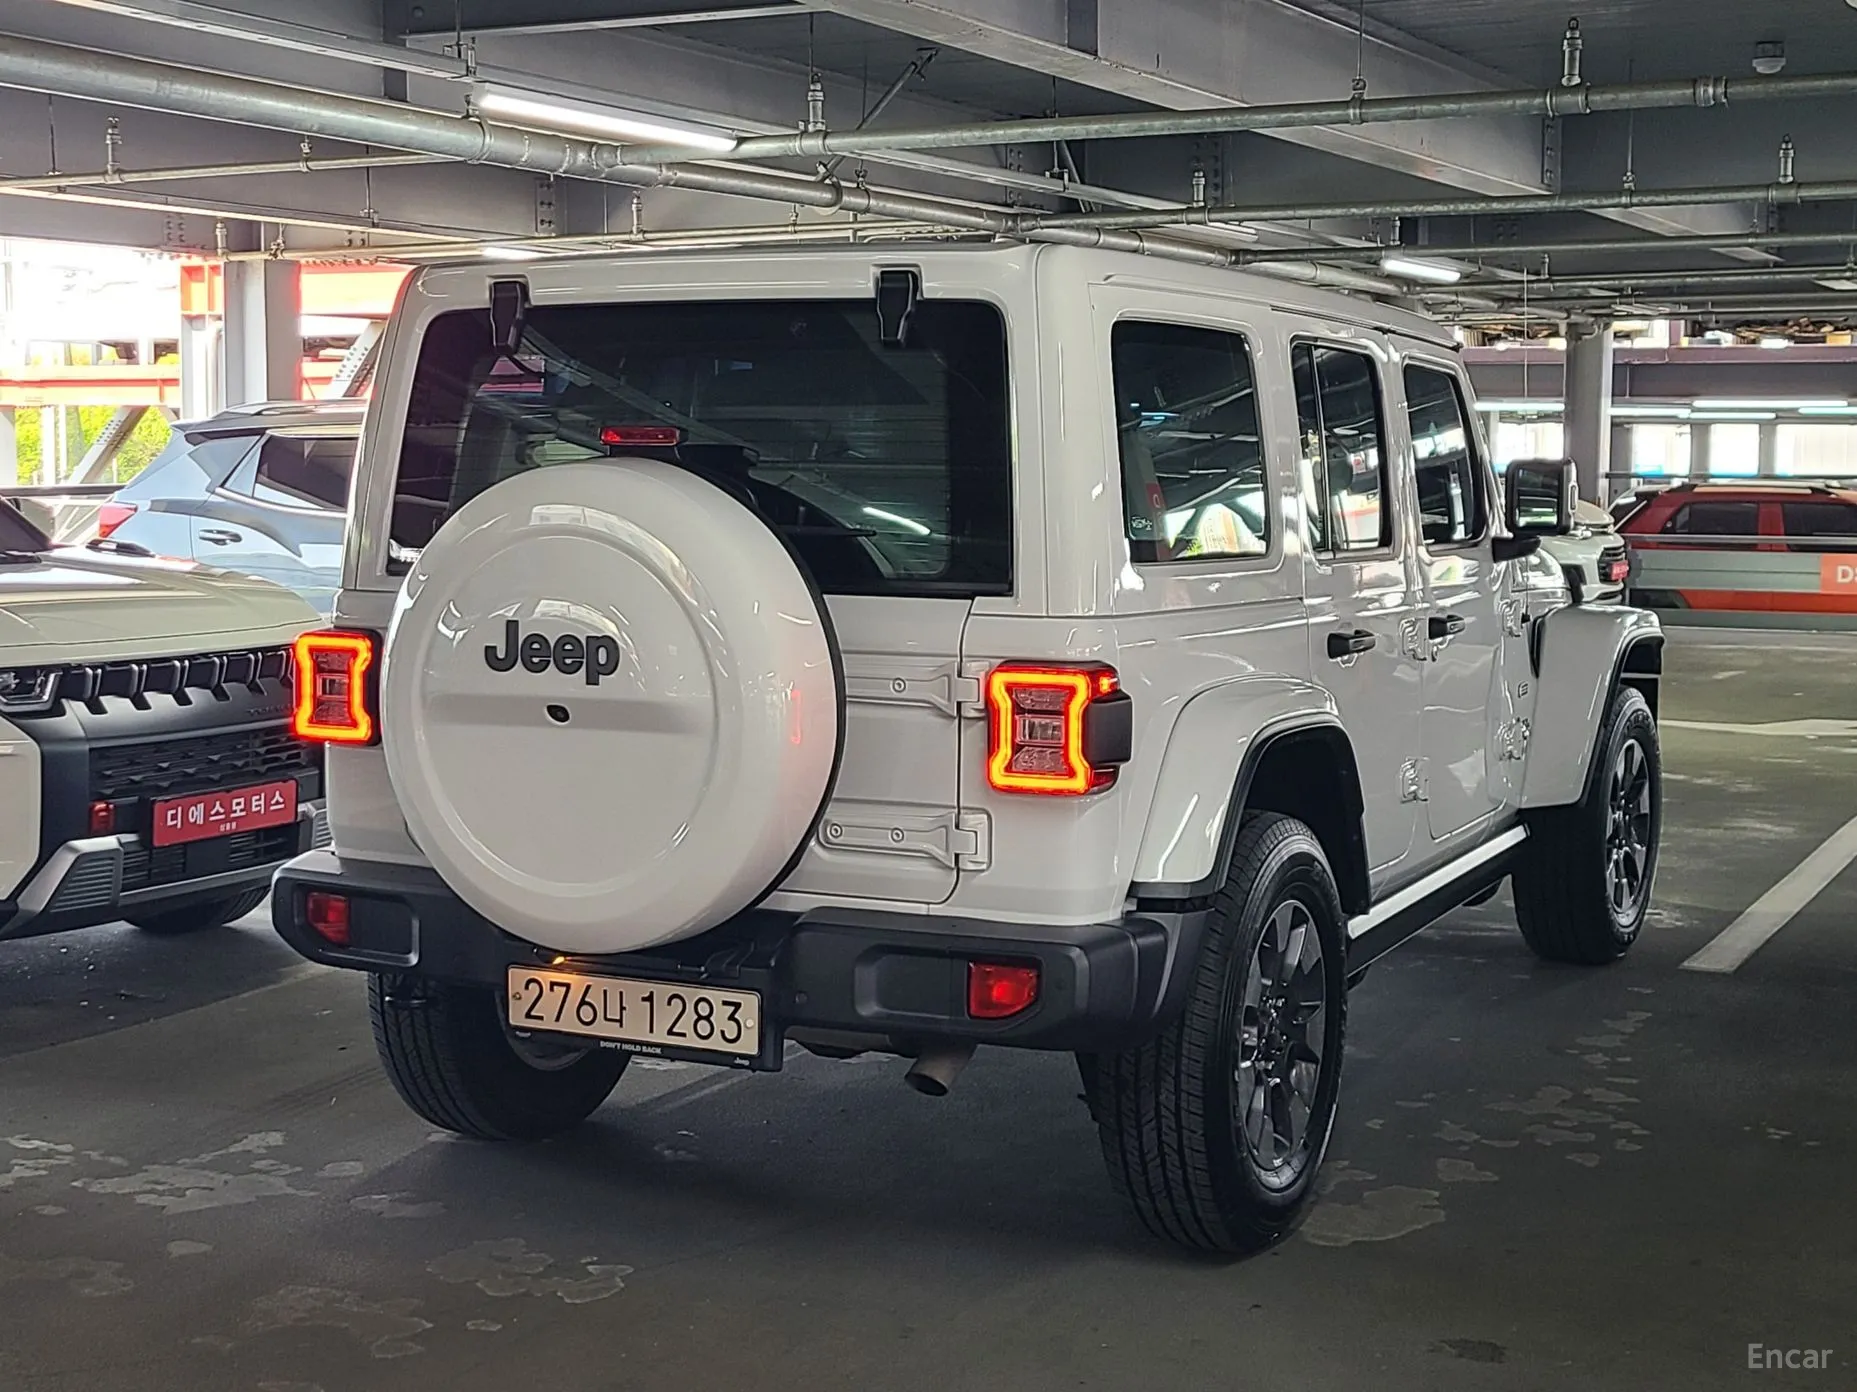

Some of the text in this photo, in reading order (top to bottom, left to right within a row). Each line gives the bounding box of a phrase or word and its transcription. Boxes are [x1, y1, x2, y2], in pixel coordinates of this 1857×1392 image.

[1837, 565, 1857, 583] D
[484, 619, 620, 685] Jeep
[166, 790, 285, 829] 디에스모터스
[524, 977, 743, 1044] 276나 1283
[622, 1042, 641, 1052] HOLD
